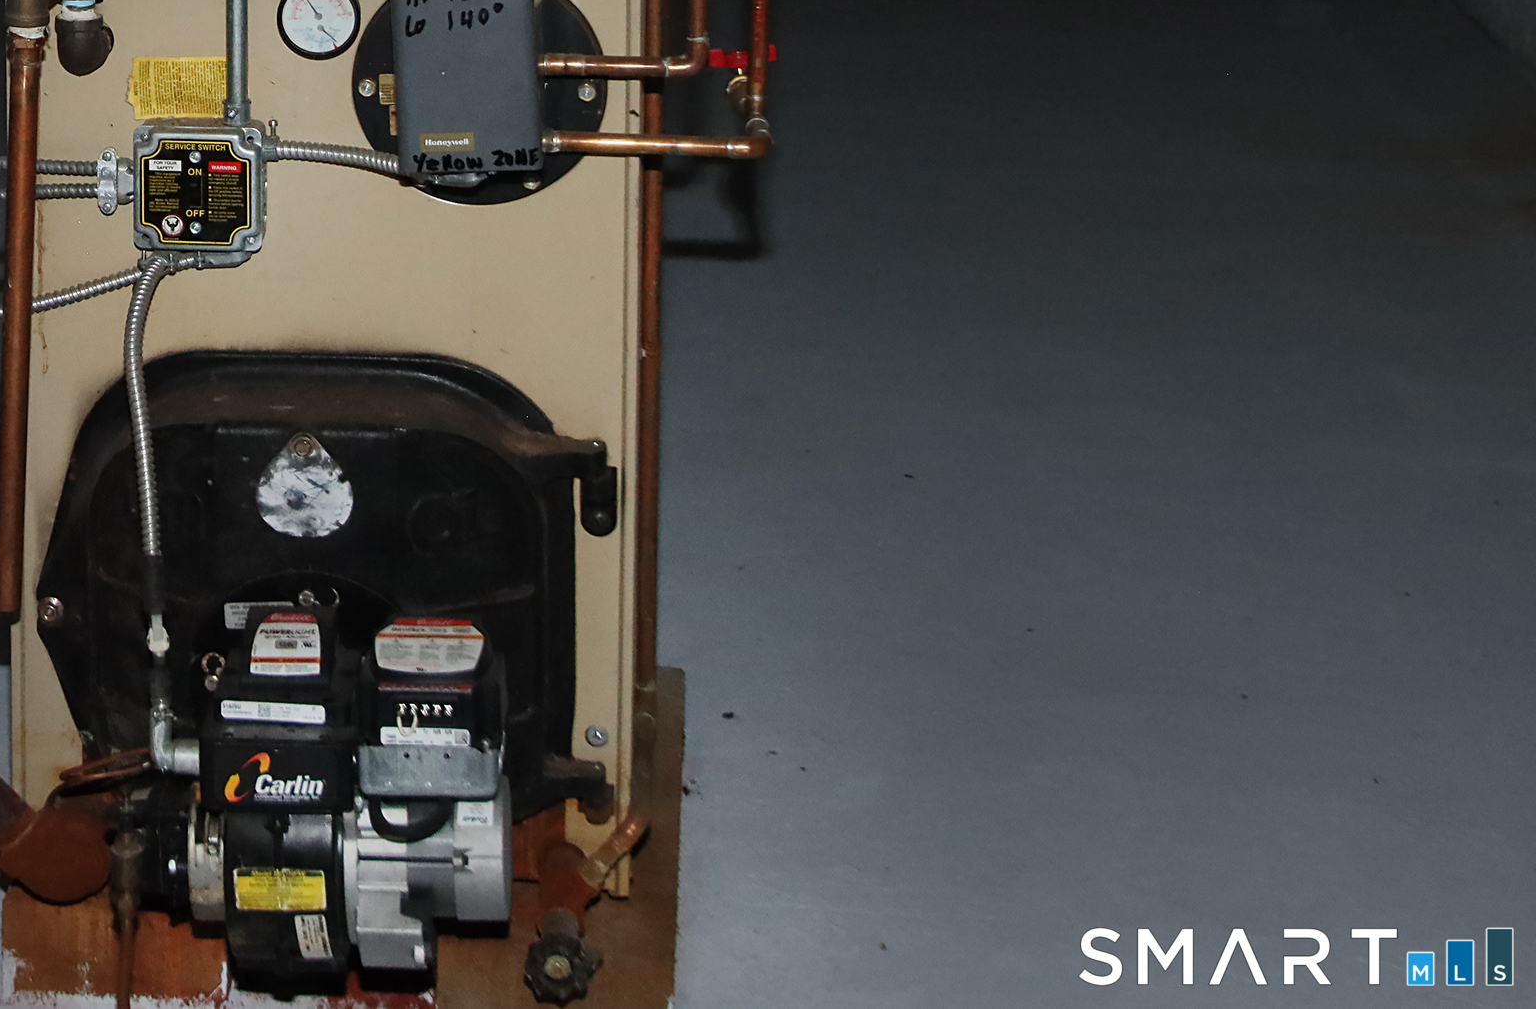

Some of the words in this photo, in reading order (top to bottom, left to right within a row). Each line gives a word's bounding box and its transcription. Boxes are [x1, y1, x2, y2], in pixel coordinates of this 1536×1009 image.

[424, 138, 469, 147] Honeywell
[165, 143, 195, 151] SERVICE
[197, 144, 226, 152] SWITCH
[188, 167, 202, 176] ON
[186, 209, 205, 218] OFF
[255, 774, 324, 795] Carlin
